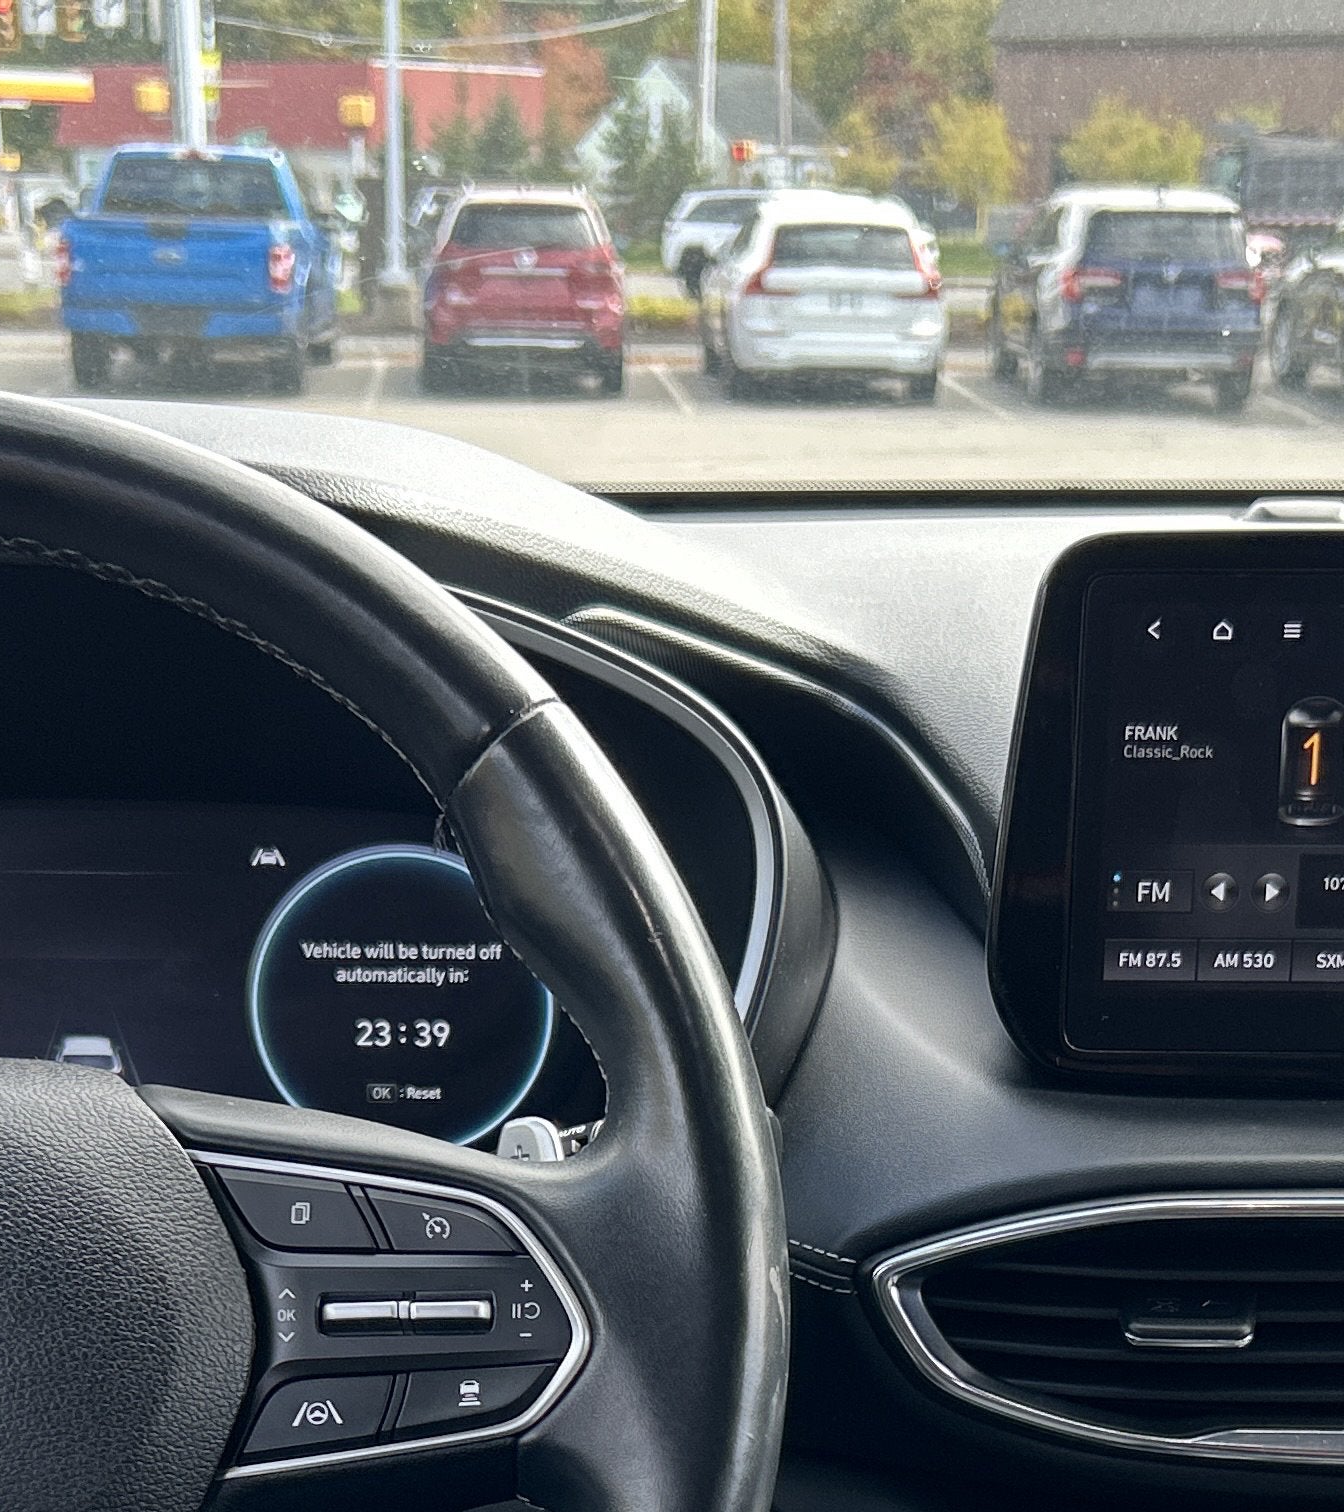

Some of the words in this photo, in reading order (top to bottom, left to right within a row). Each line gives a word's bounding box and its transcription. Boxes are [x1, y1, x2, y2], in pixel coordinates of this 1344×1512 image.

[1124, 725, 1178, 741] FRANK
[1123, 744, 1213, 760] Classic_Rock
[1136, 882, 1170, 903] FM
[301, 943, 361, 959] Vehicle
[365, 944, 394, 959] will
[399, 944, 418, 959] be
[421, 944, 475, 960] turned
[479, 944, 502, 960] off
[1118, 952, 1142, 967] FM
[1145, 952, 1182, 967] 87.5
[1213, 952, 1239, 968] AM
[1242, 952, 1275, 968] 530
[335, 968, 446, 987] automatically
[372, 1087, 391, 1099] OK
[277, 1308, 296, 1322] OK
